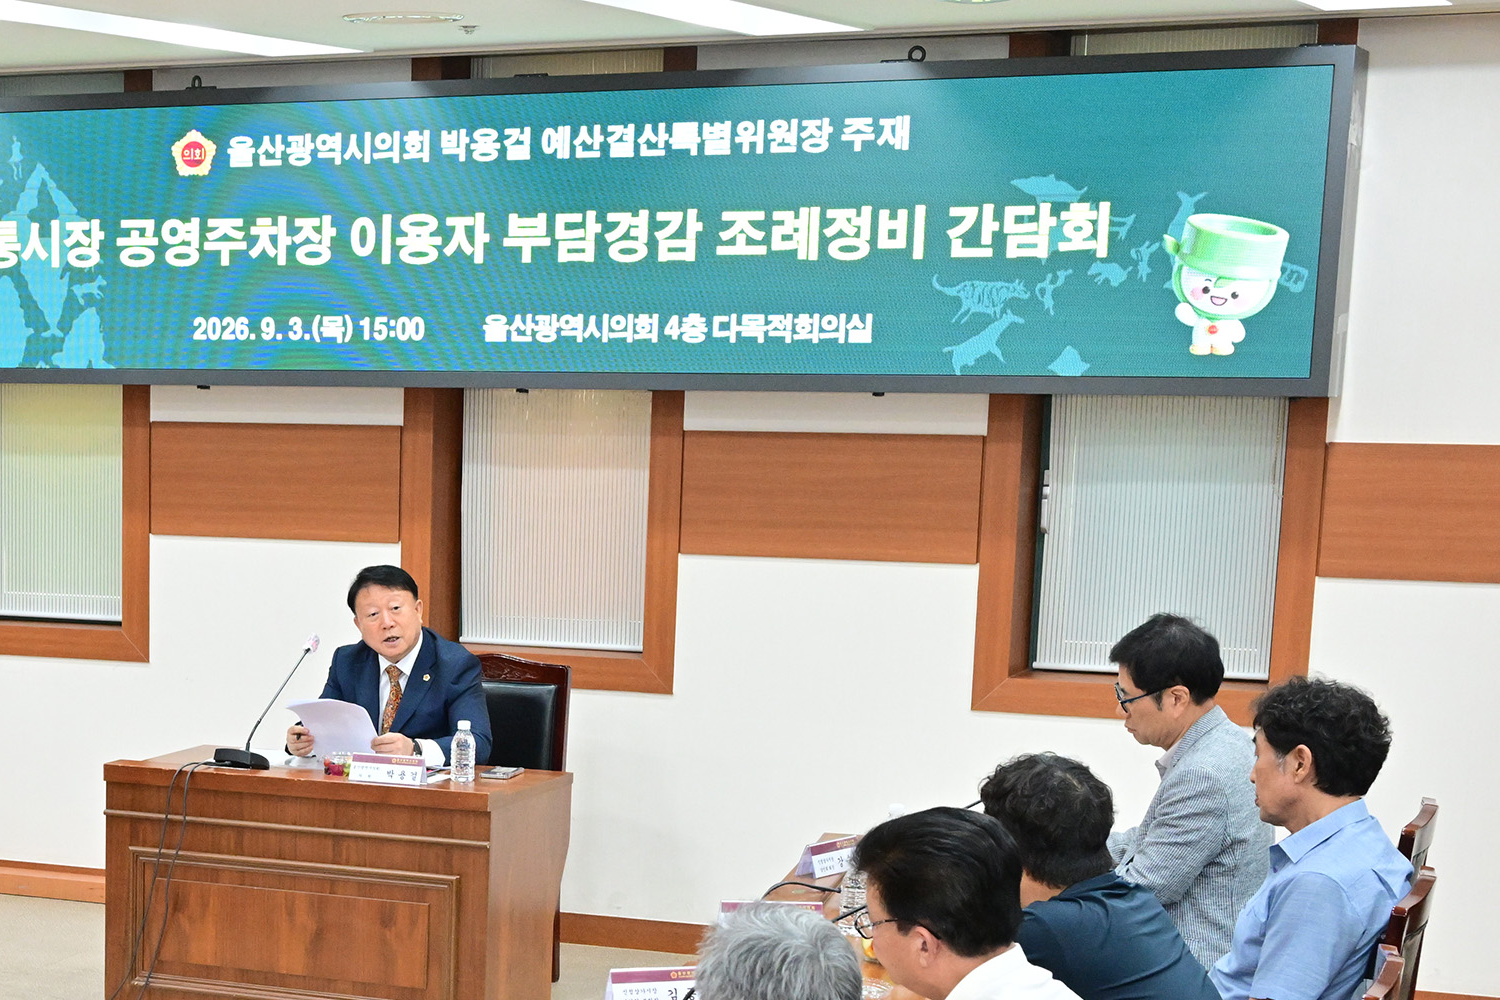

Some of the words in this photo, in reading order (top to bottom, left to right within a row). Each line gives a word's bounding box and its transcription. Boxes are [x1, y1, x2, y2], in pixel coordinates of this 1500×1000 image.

[183, 147, 206, 161] 의회
[227, 130, 431, 168] 울산광역시의회
[440, 126, 531, 162] 박용걸
[541, 117, 834, 159] 예산결산특별위원장
[840, 114, 911, 152] 주재
[116, 214, 337, 268] 공영주차장
[350, 212, 491, 265] 이용자
[502, 208, 704, 264] 부담경감
[716, 204, 927, 261] 조례정비
[946, 201, 1111, 259] 간담회
[359, 316, 425, 341] 15:00
[482, 313, 659, 343] 울산광역시의회
[663, 313, 708, 344] 4층
[712, 313, 873, 344] 다목적회의실
